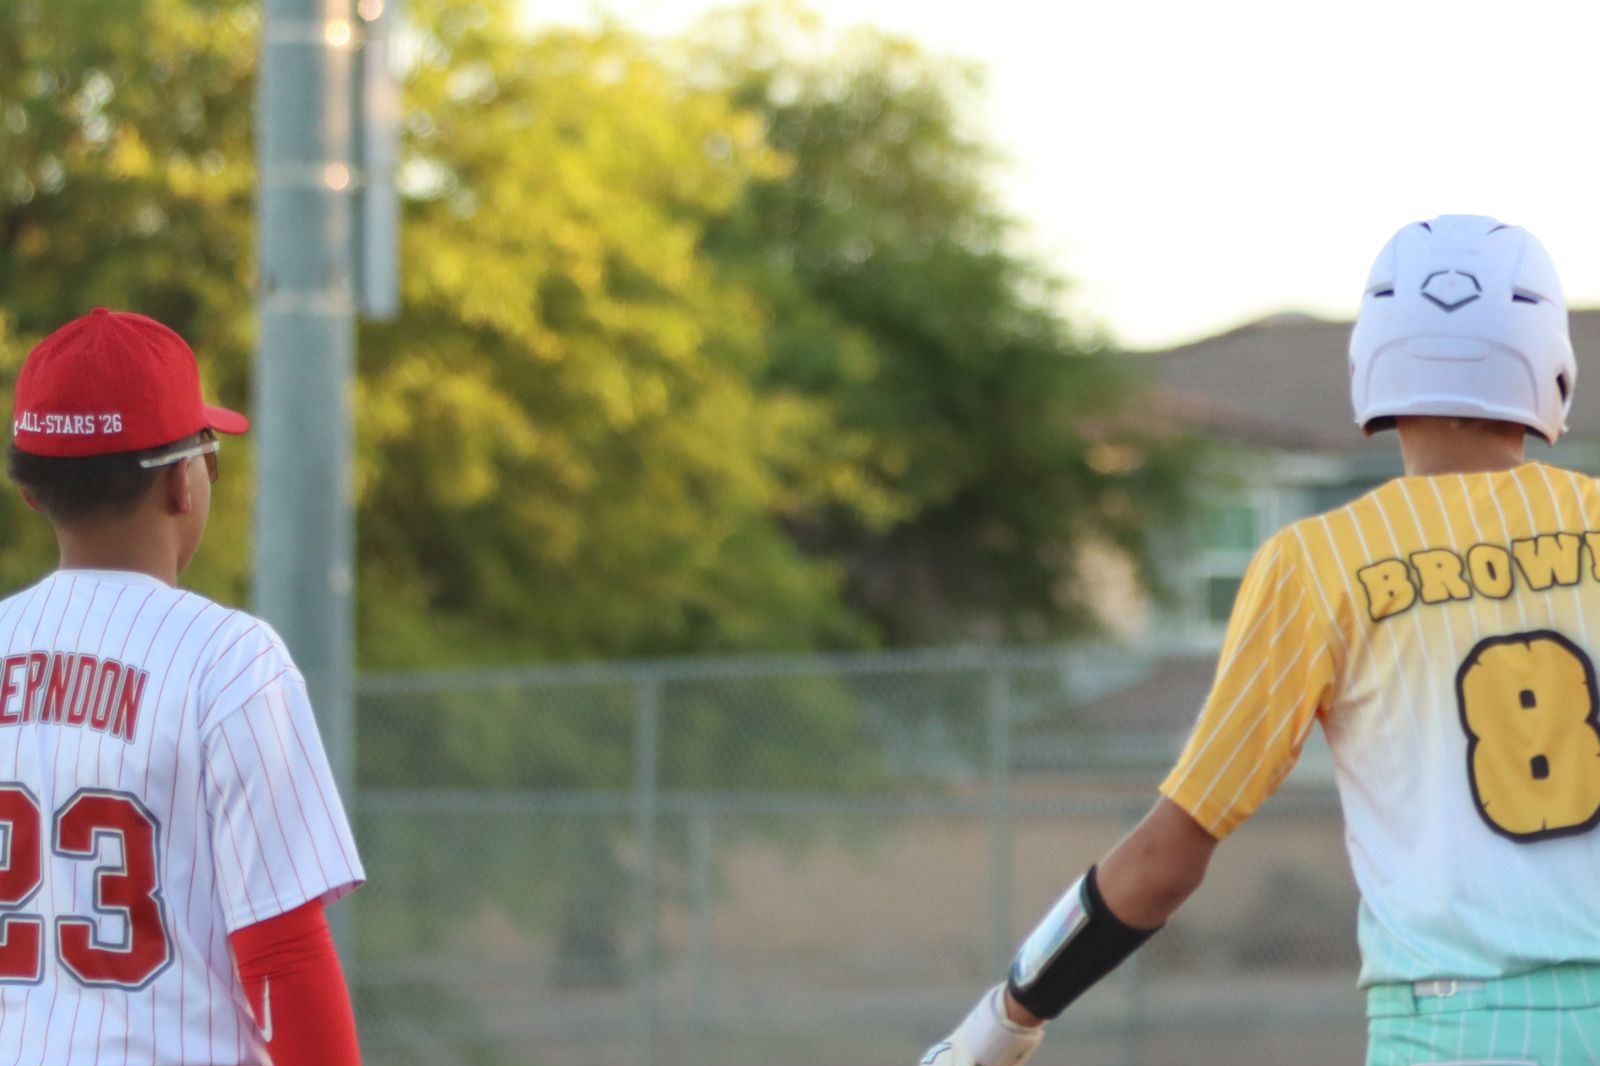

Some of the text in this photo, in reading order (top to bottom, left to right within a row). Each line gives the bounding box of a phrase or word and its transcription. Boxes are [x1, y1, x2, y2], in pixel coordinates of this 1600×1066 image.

[20, 411, 122, 435] ALL-STARS '26
[0, 650, 150, 744] ERNDON
